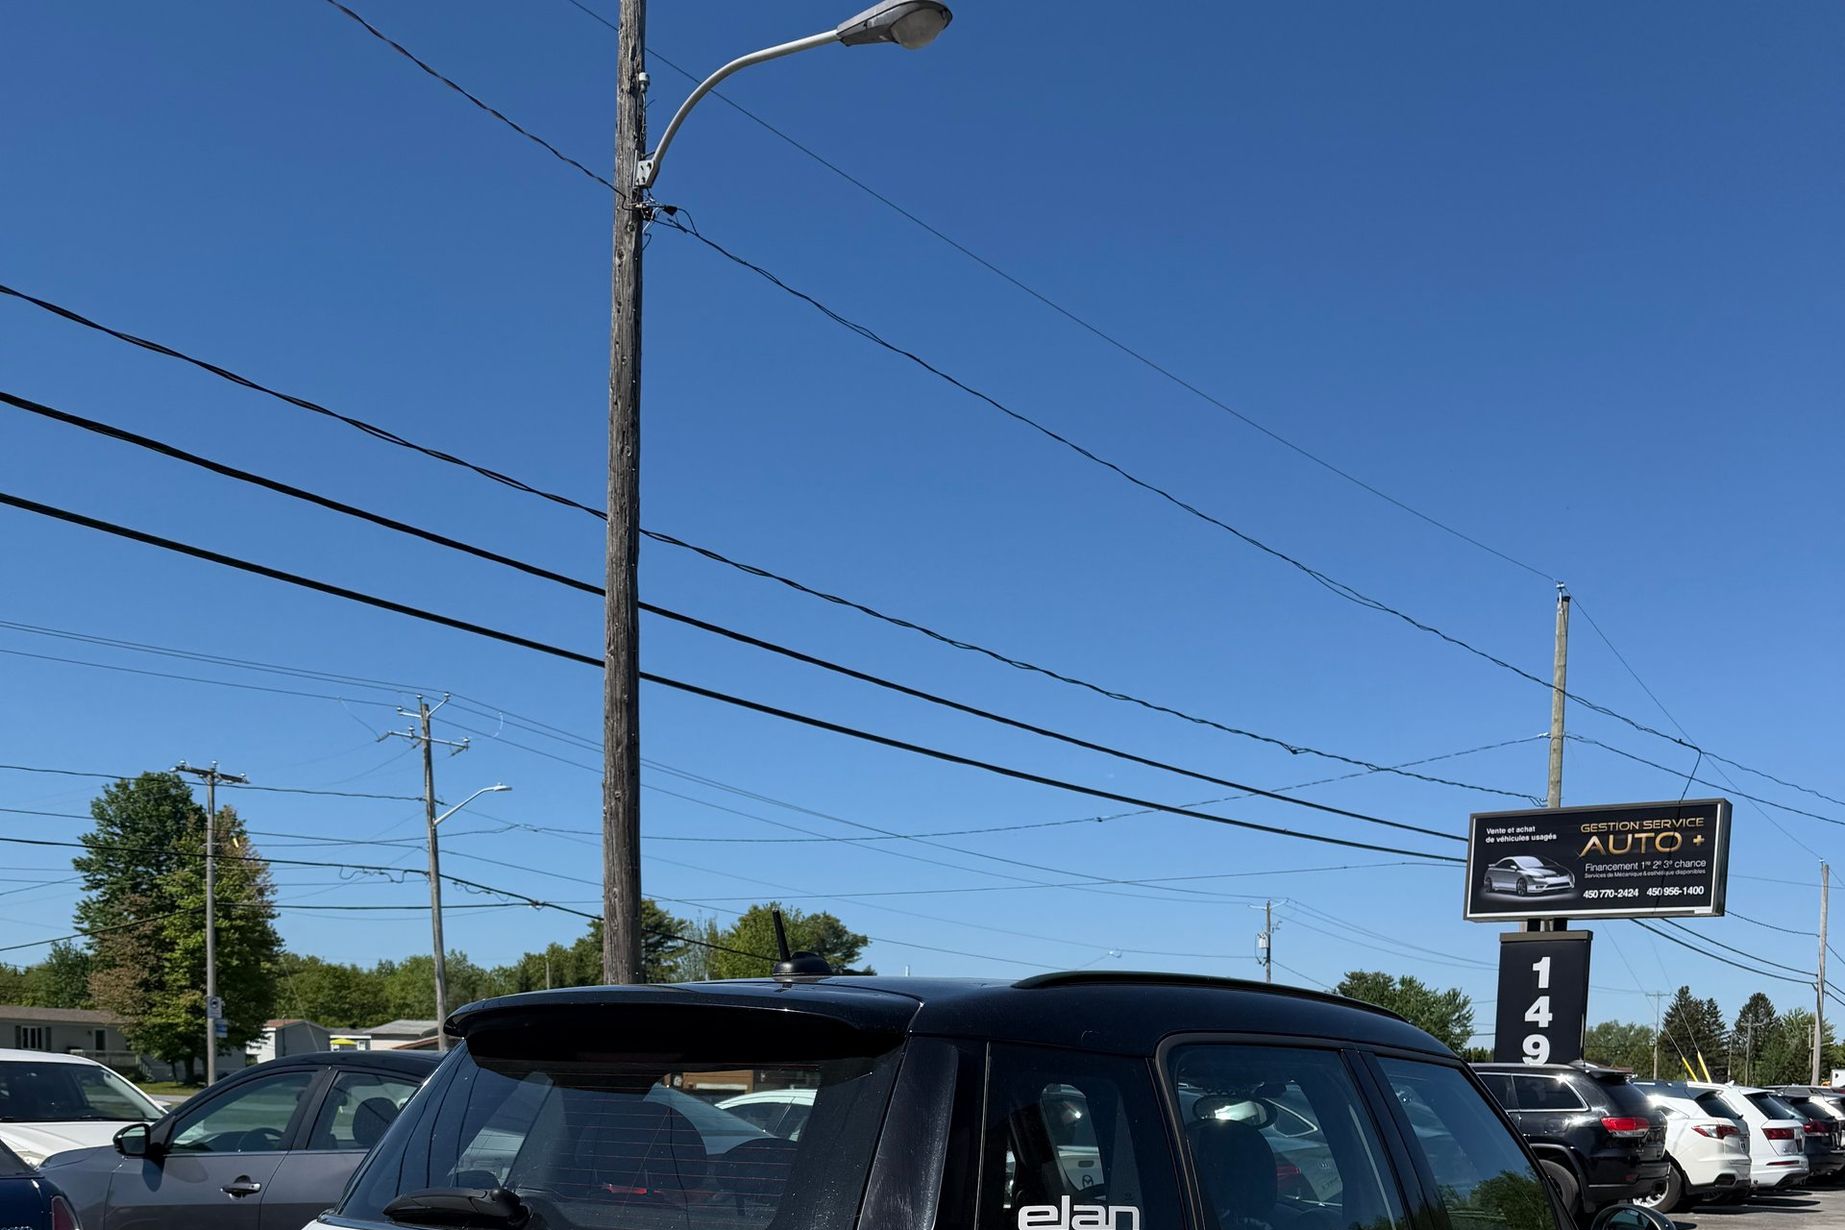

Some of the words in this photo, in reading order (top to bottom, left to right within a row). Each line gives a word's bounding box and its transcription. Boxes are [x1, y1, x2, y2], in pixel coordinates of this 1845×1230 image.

[1486, 827, 1506, 835] Vente
[1515, 825, 1536, 833] achat
[1580, 821, 1639, 833] GESTION
[1642, 817, 1704, 830] SERVICE
[1496, 835, 1530, 843] véhicules
[1531, 833, 1557, 842] usagés
[1578, 831, 1683, 857] AUTO
[1585, 862, 1639, 872] Financement
[1674, 858, 1707, 869] chance
[1675, 867, 1706, 876] disponibles
[1583, 889, 1599, 899] 450
[1599, 888, 1639, 898] 770-2424
[1646, 886, 1662, 897] 450
[1663, 885, 1705, 896] 956-1400
